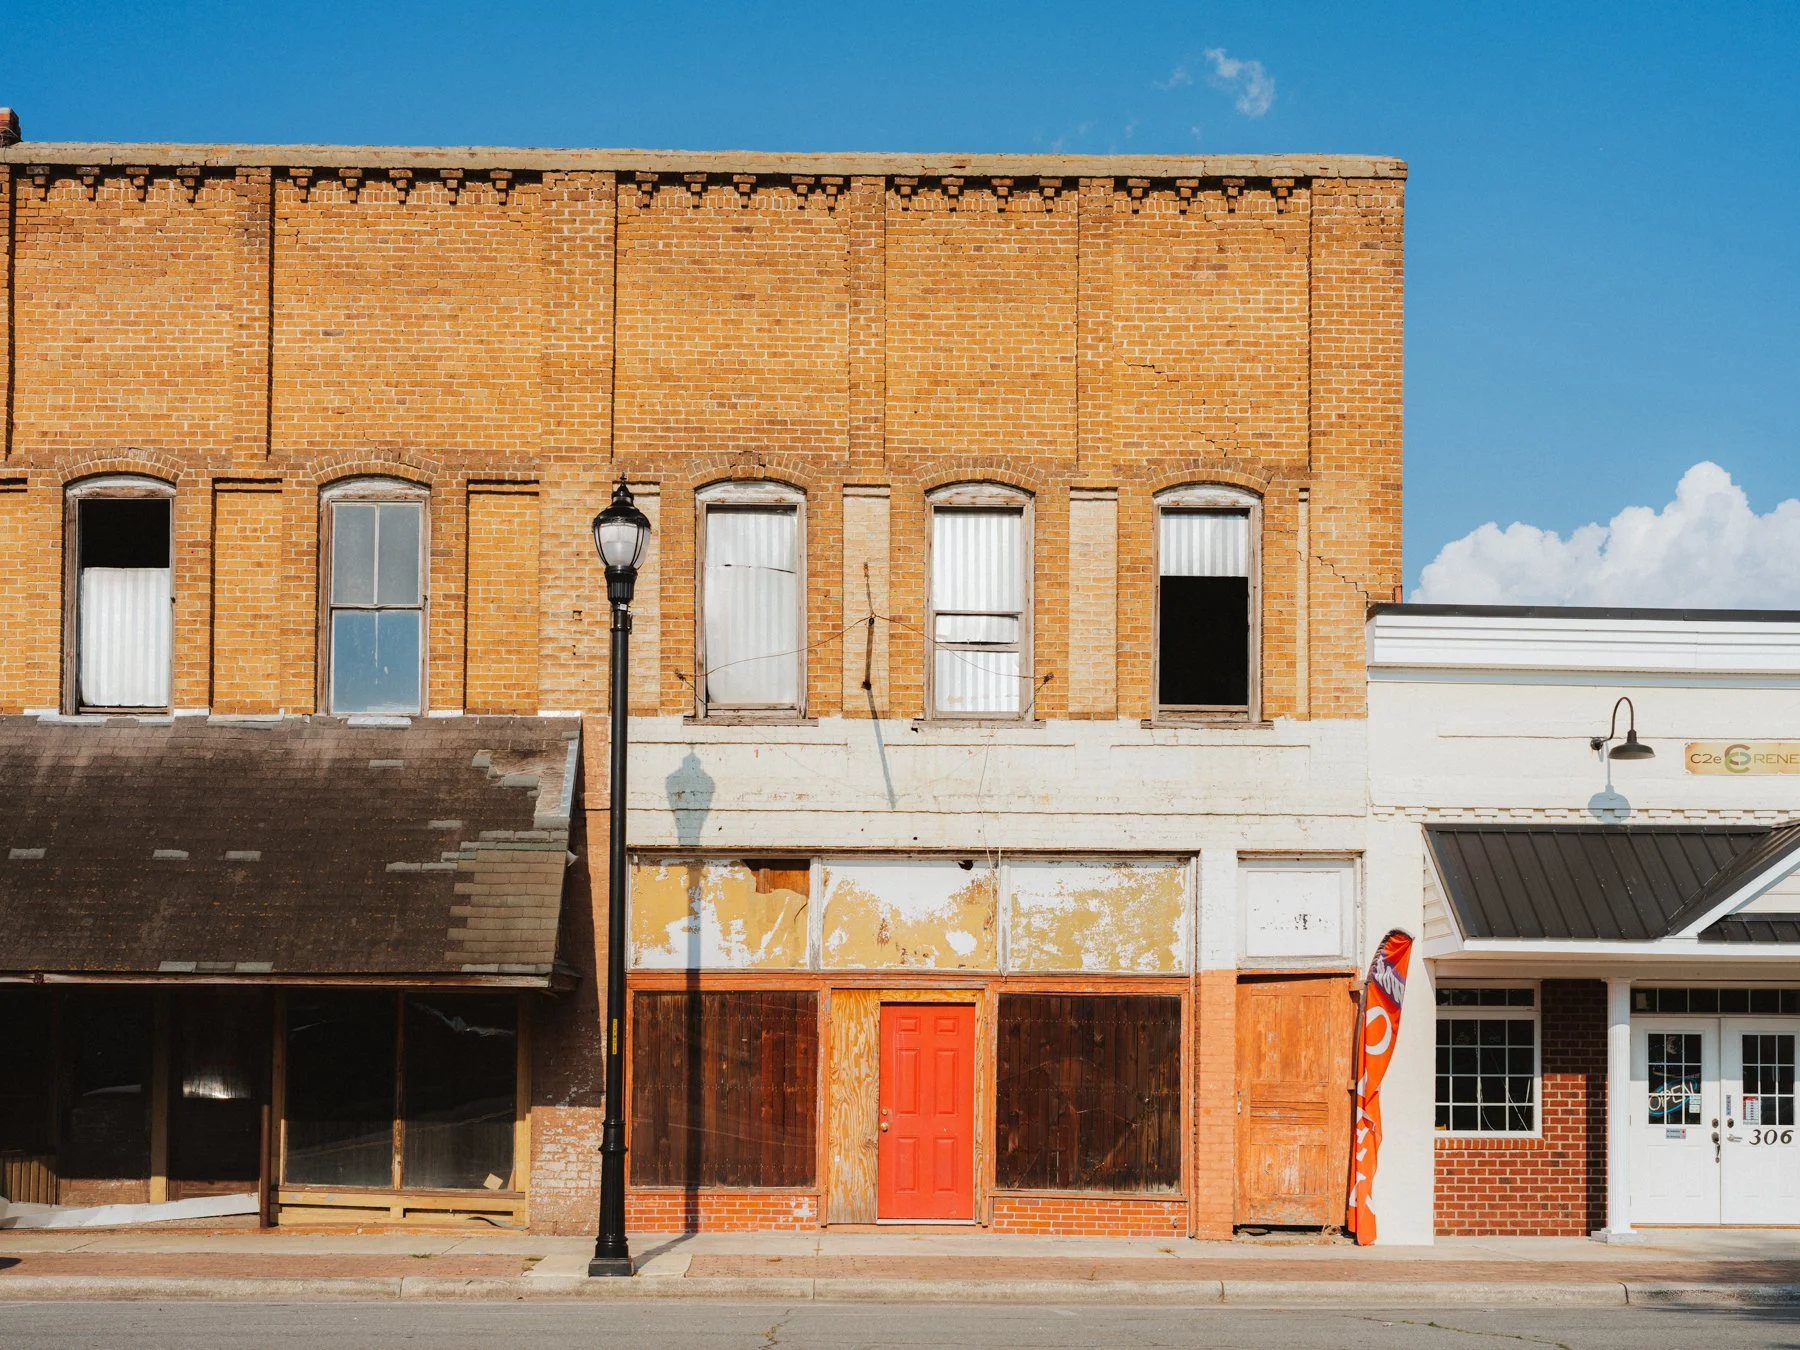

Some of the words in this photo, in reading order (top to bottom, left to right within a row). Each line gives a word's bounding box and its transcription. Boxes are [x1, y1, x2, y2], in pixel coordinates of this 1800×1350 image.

[1690, 753, 1722, 764] C2e
[1648, 1081, 1694, 1111] OPEN
[1749, 1129, 1795, 1145] 306
